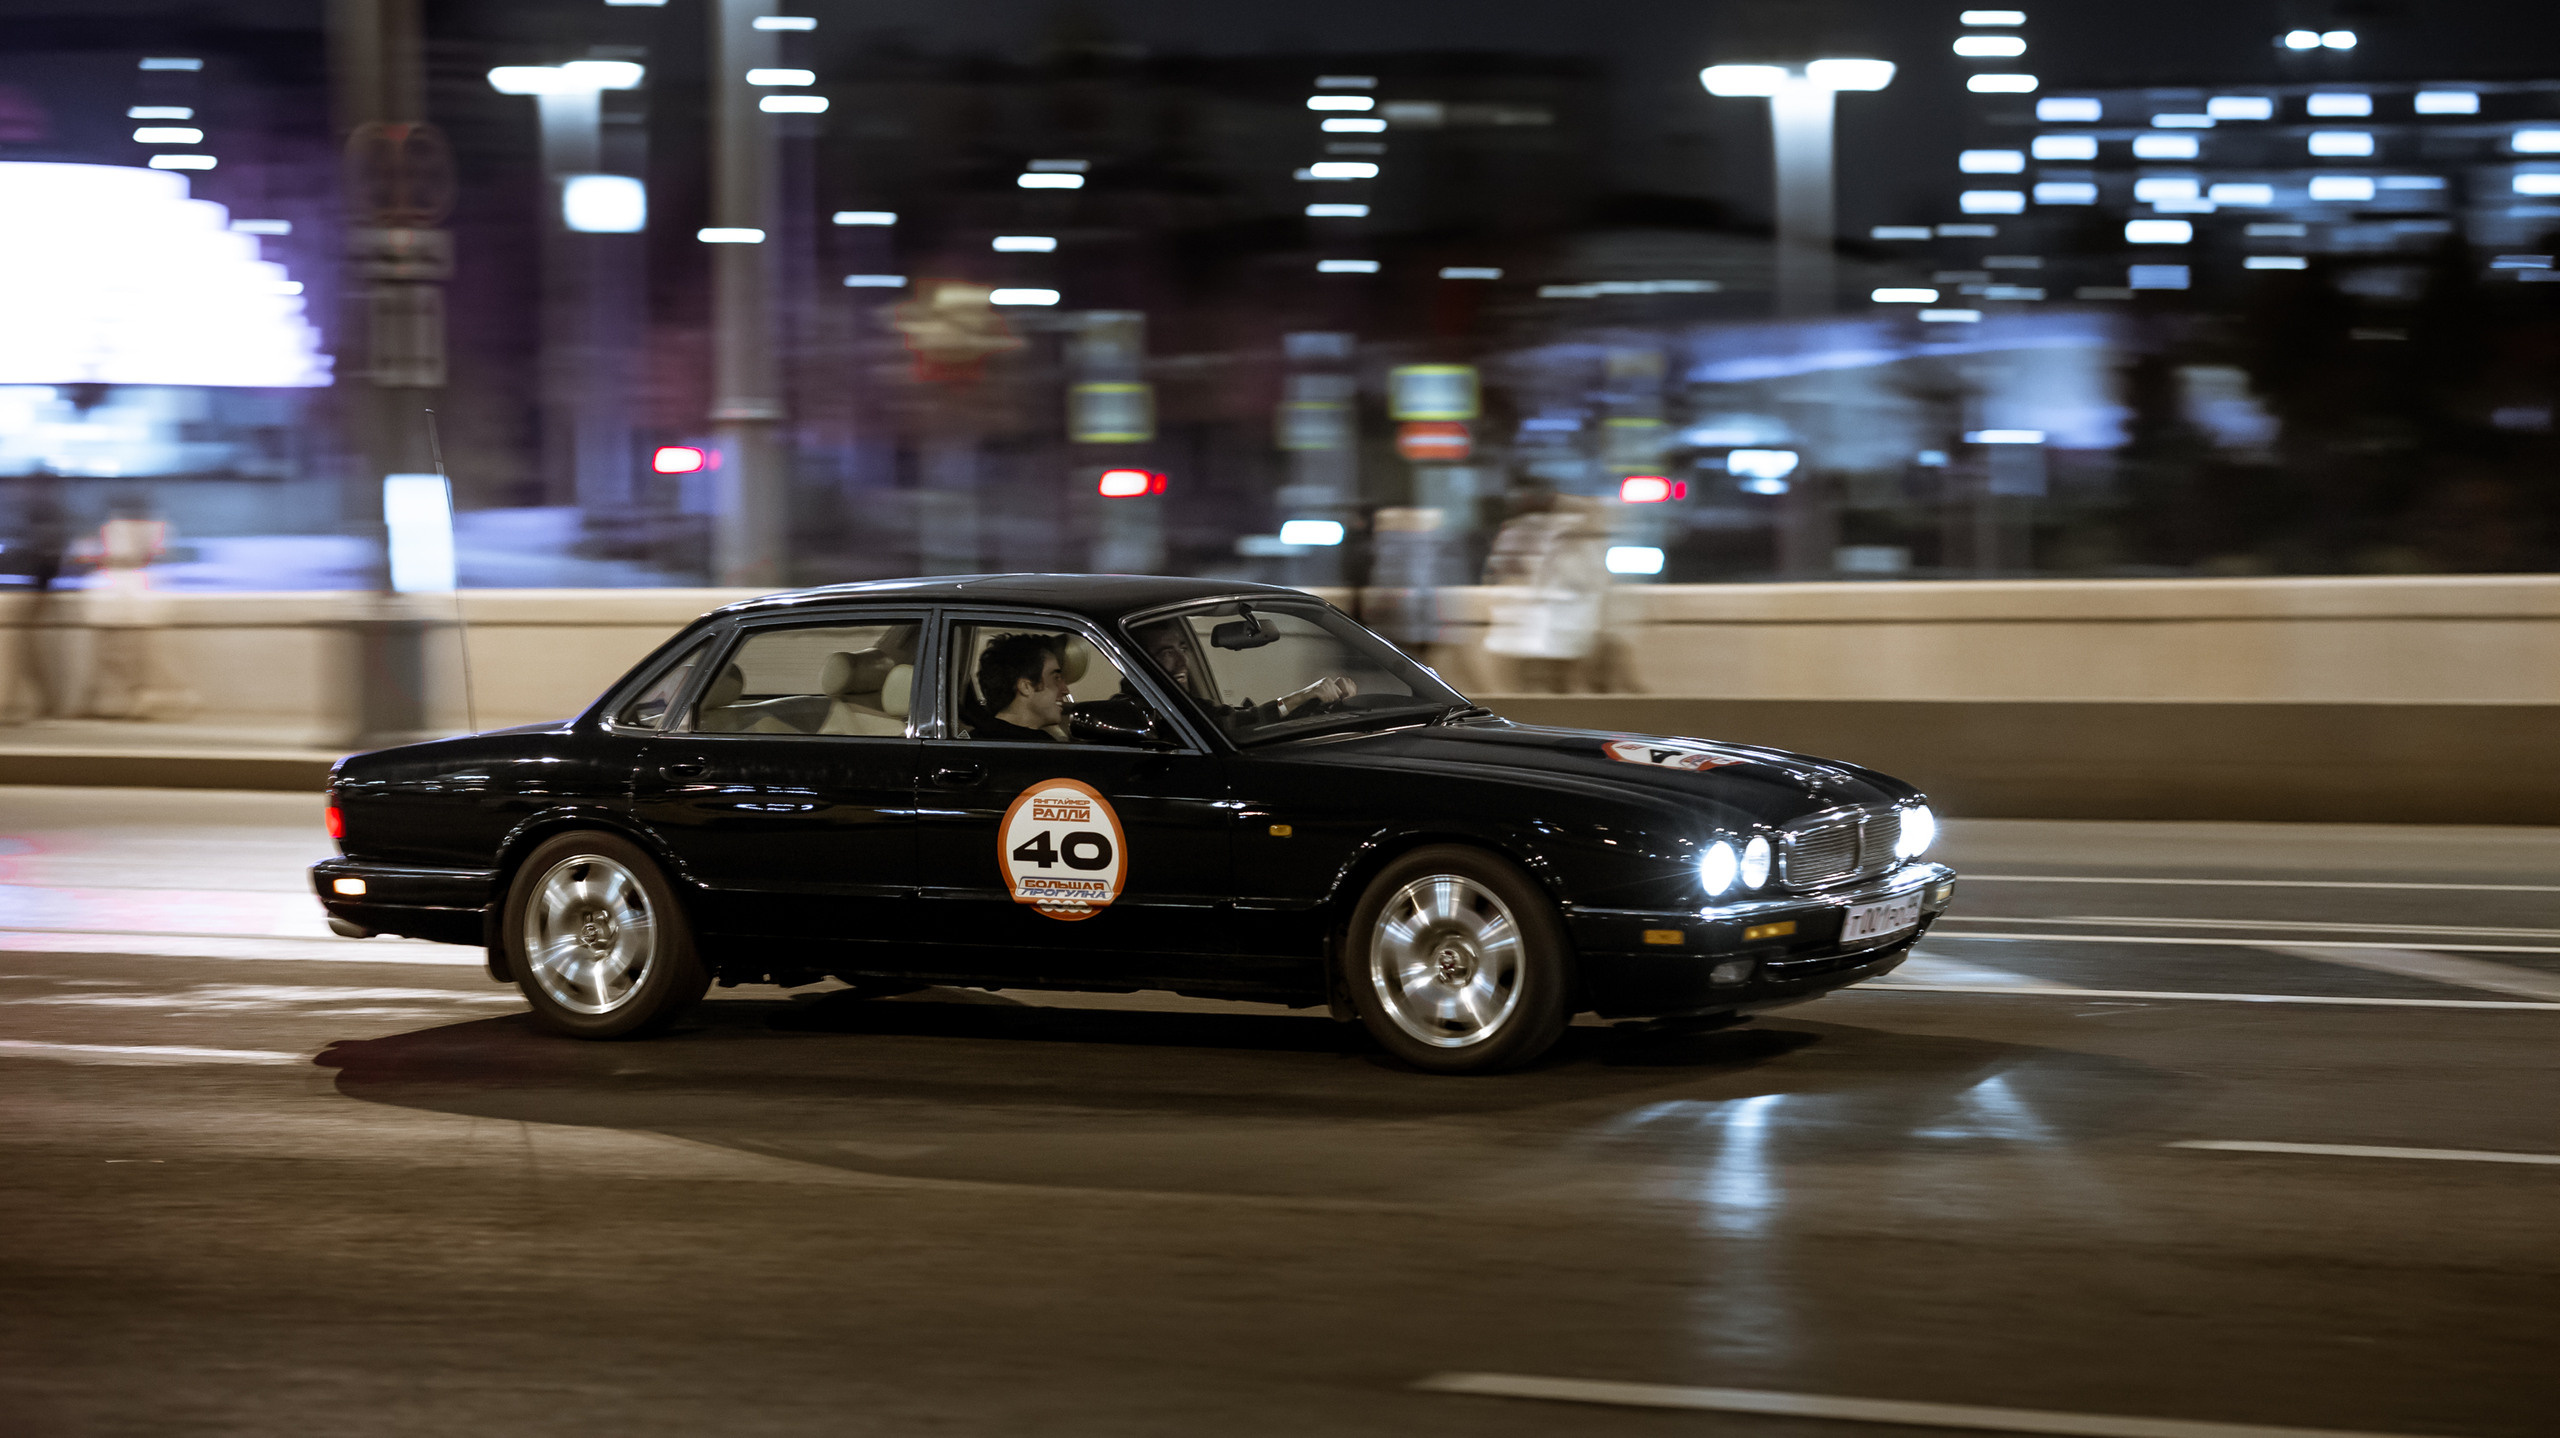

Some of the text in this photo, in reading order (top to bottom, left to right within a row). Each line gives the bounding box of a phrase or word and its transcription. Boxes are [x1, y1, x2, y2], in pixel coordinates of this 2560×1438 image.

[1033, 808, 1090, 820] РАЛЛИ
[1013, 831, 1112, 871] 40
[1025, 880, 1104, 890] БОЛЬШАЯ
[1021, 888, 1106, 898] ПРОГУЛКА
